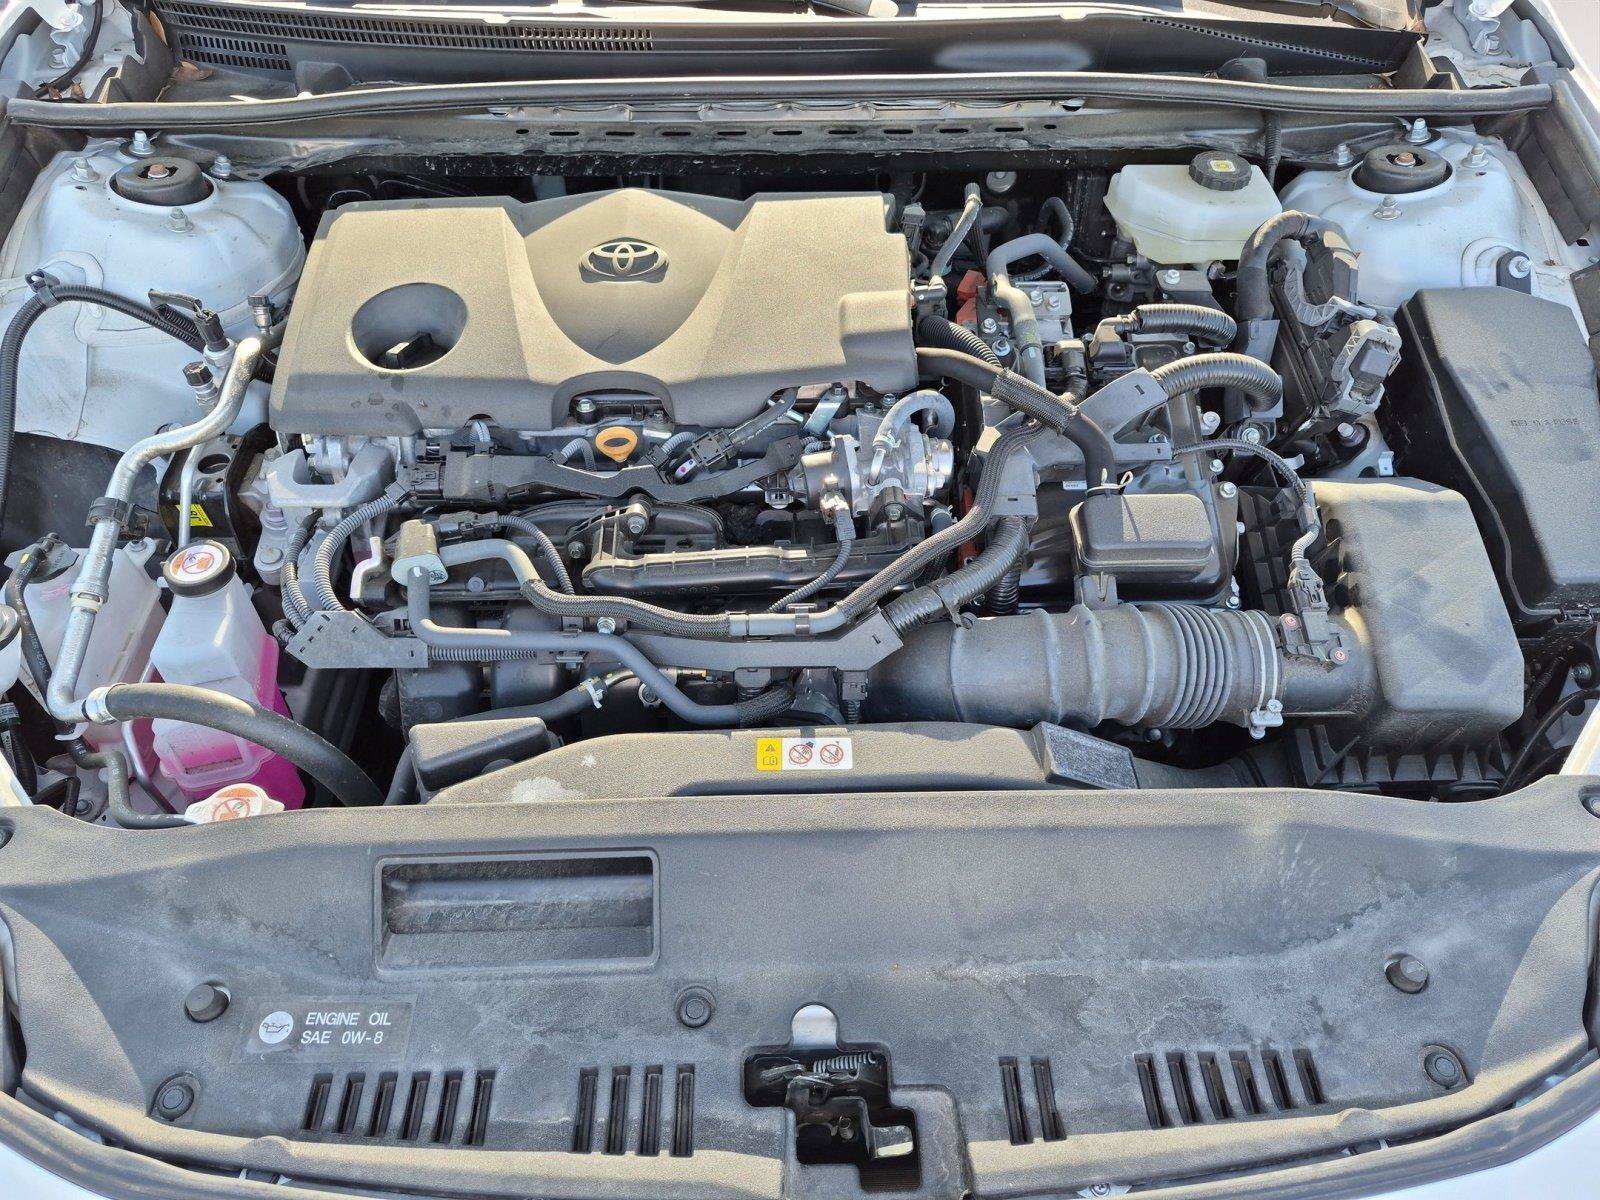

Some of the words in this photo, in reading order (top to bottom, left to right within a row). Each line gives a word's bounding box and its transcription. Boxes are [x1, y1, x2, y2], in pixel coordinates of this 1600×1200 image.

[305, 1011, 360, 1026] ENGINE
[369, 1011, 392, 1026] OIL
[300, 1030, 332, 1044] SAE
[341, 1030, 384, 1045] 0W-8
